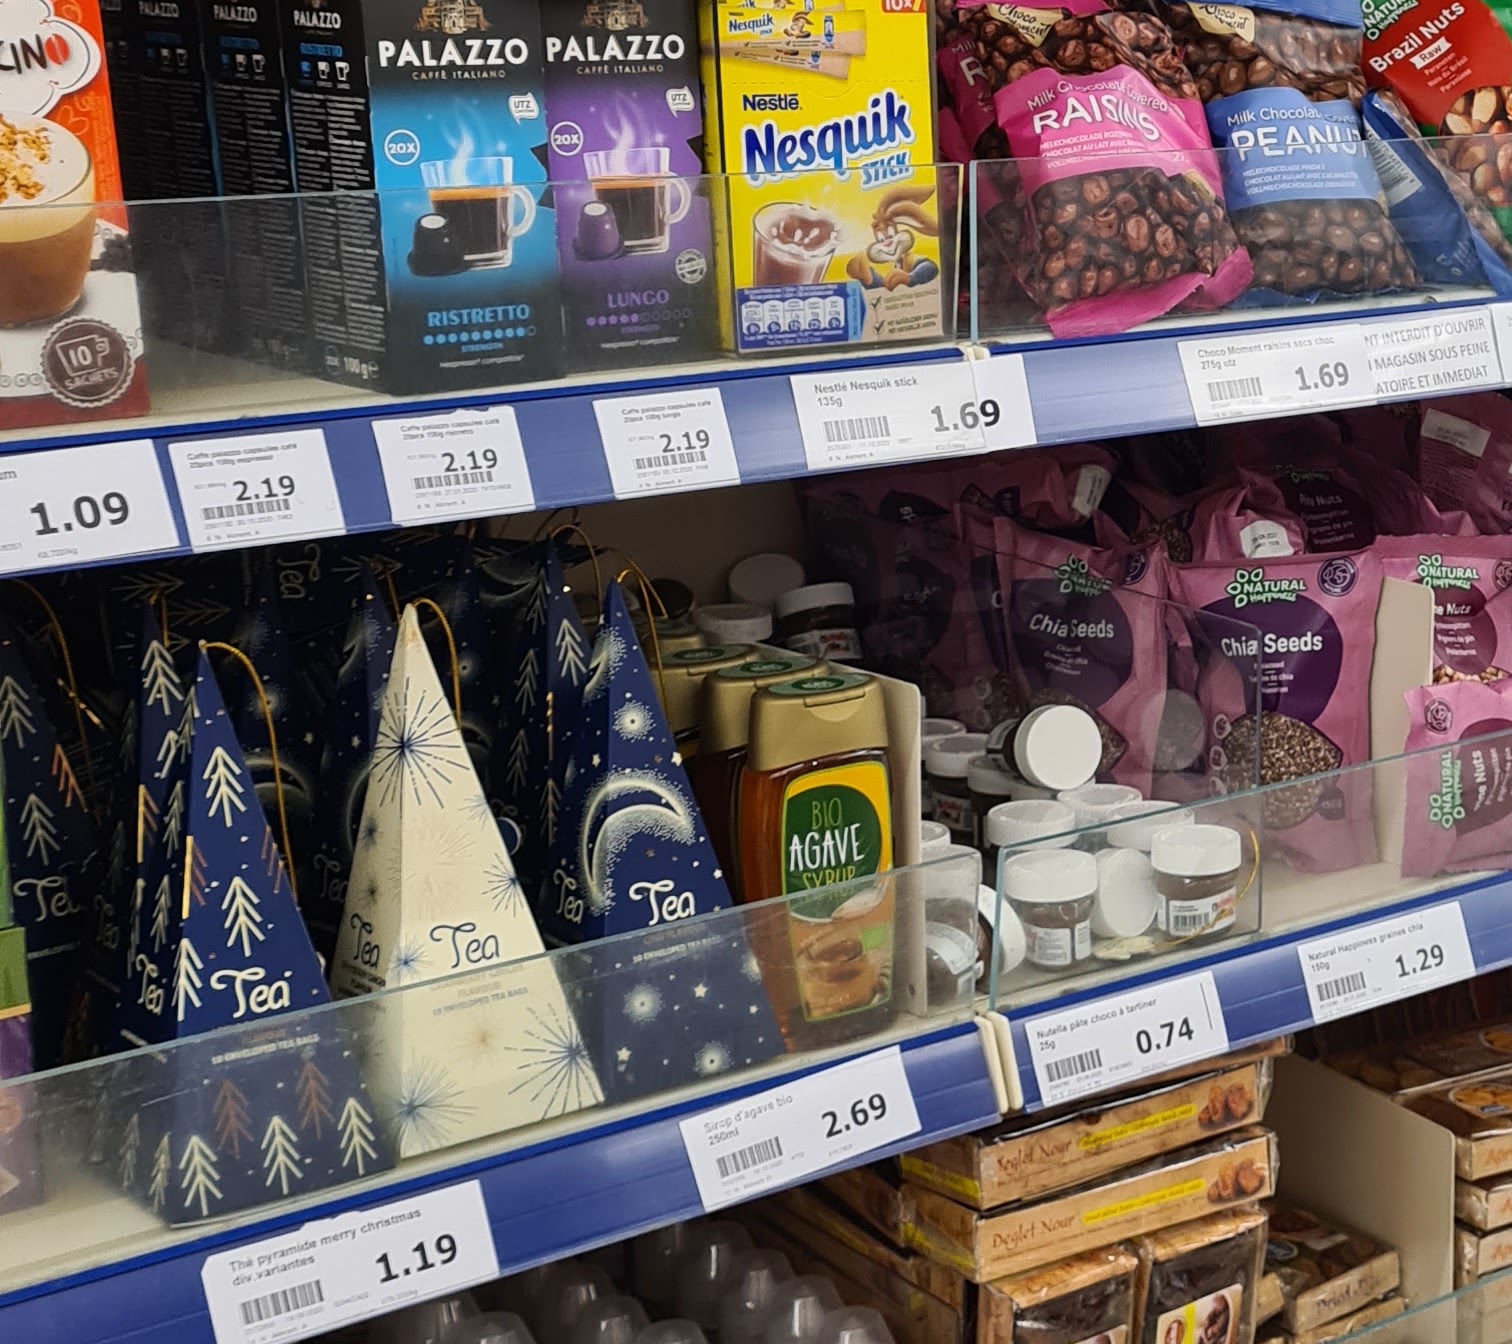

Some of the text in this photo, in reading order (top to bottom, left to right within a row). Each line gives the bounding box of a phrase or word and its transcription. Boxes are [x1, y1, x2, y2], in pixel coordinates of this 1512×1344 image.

[546, 34, 686, 62] PALAZZO
[1367, 0, 1466, 74] Brazil Nuts
[379, 37, 529, 68] PALAZZO
[1419, 45, 1443, 63] Raw
[451, 67, 507, 82] ITALIANO
[614, 62, 665, 76] ITALIANO
[742, 92, 802, 112] Nestlé
[1027, 88, 1056, 112] Milk
[1032, 94, 1160, 142] RAISINS
[1227, 111, 1256, 127] Milk
[387, 140, 417, 155] 20X
[744, 91, 912, 182] Nesquik
[861, 151, 914, 185] STICK
[606, 288, 669, 309] LUNGO
[426, 303, 530, 328] RISTRETTO
[1381, 317, 1487, 345] INTERDIT D'OUVRIR
[68, 346, 92, 367] 10
[1197, 336, 1335, 360] Choco Moment raisins choc
[1374, 341, 1491, 372] MAGASIN SOUS PEINE
[64, 367, 119, 391] SACHETS
[1200, 358, 1236, 371] 275g utz
[1294, 361, 1350, 391] 1.69
[1376, 364, 1489, 395] ATOIRE ET IMMEDIAT
[814, 375, 919, 395] Nestlé Nesquik stick
[817, 396, 842, 410] 135g
[930, 399, 1001, 432] 1.69
[658, 429, 711, 454] 2.19
[441, 447, 499, 473] 2.19
[233, 474, 296, 501] 2.19
[29, 490, 131, 536] 1.09
[1243, 577, 1307, 594] NATURAL
[1220, 631, 1324, 657] Chia Seeds
[811, 796, 843, 832] BIO
[787, 822, 866, 871] AGAVE
[628, 878, 697, 927] Tea
[430, 920, 500, 969] Tea
[1308, 921, 1424, 964] Natural Happiness graines chia
[1396, 943, 1444, 978] 1.29
[209, 965, 292, 1018] Tea
[1037, 997, 1158, 1041] Nutella pâte choco tartiner
[1135, 1016, 1195, 1055] 0.74
[703, 1093, 794, 1134] Sirop d'agave bio
[821, 1092, 887, 1139] 2.69
[255, 1208, 422, 1270] pyramide merry christmas
[374, 1233, 458, 1285] 1.19
